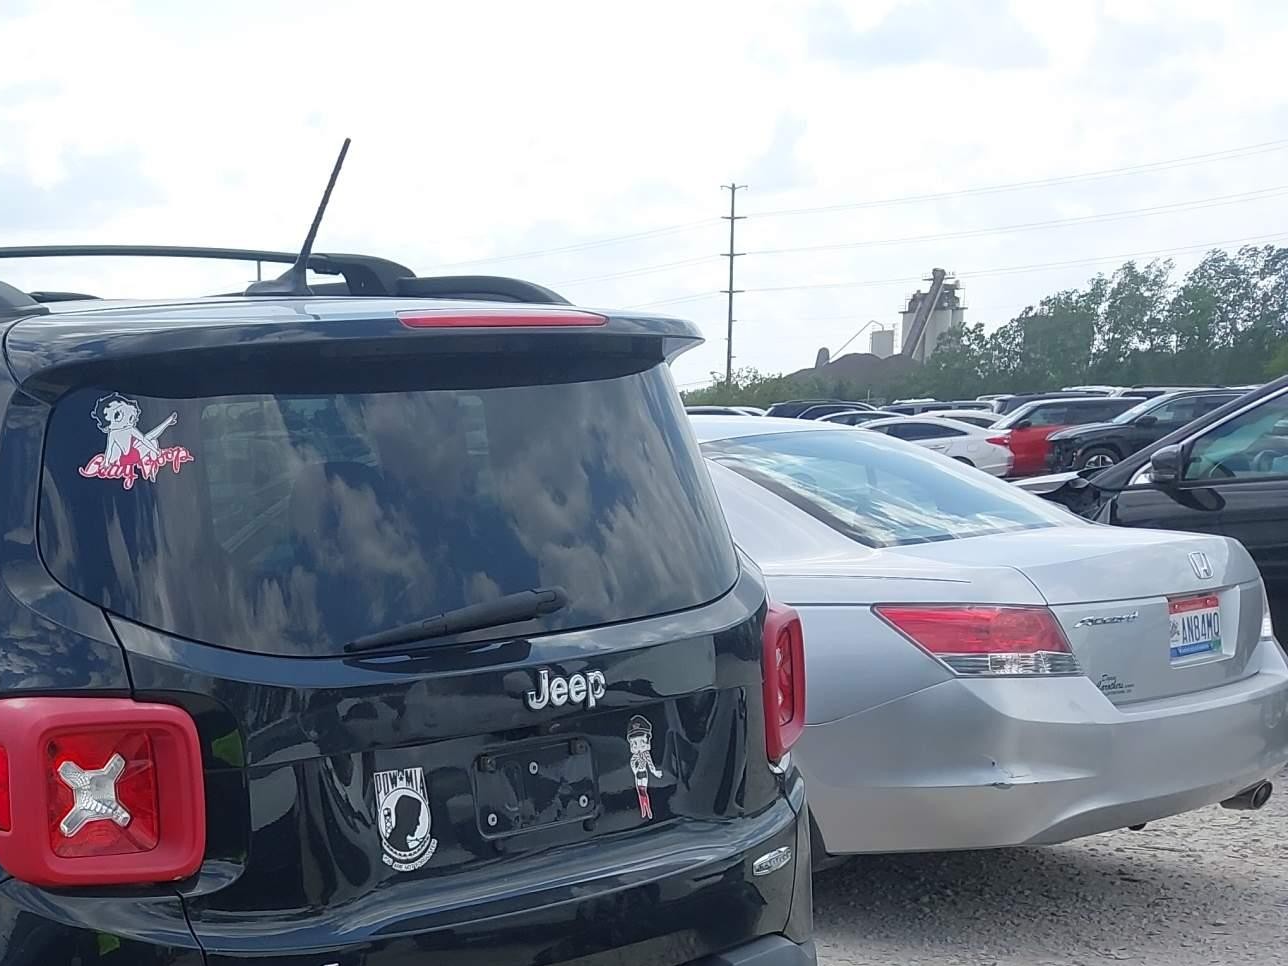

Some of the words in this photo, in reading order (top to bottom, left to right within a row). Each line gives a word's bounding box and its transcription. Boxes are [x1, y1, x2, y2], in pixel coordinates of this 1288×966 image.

[1074, 611, 1139, 628] Accord
[527, 670, 606, 710] Jeep
[374, 770, 399, 802] POW
[404, 767, 429, 802] MIA
